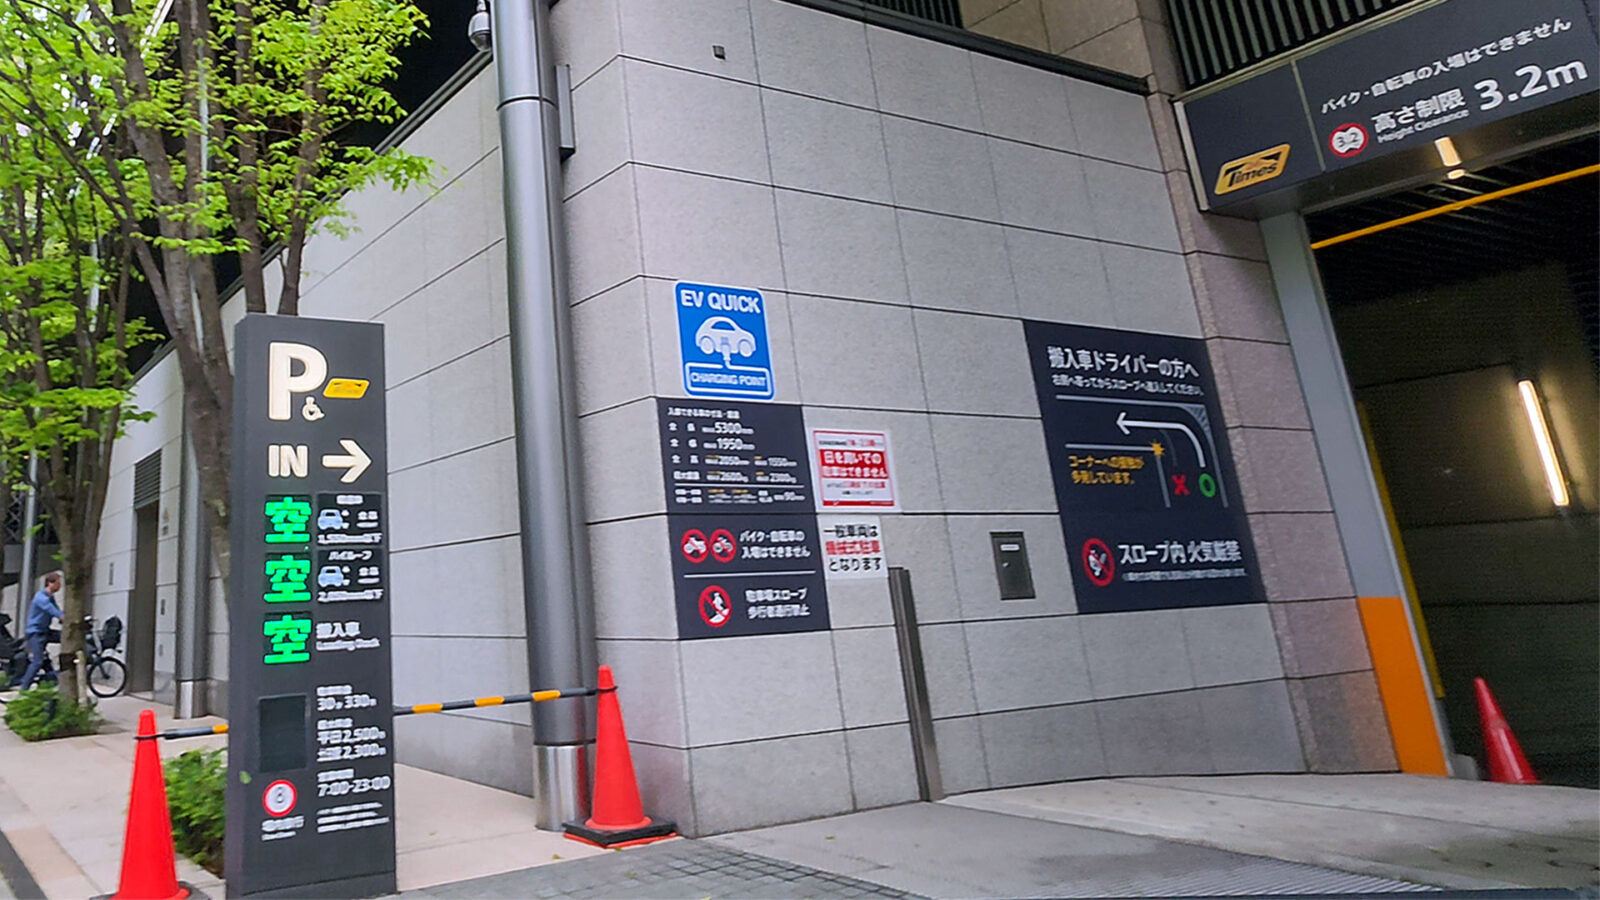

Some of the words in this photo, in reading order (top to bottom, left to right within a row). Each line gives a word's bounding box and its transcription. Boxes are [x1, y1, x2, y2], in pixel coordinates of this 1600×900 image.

[1321, 18, 1572, 114] バイク・自転車の入場はできません
[1371, 88, 1466, 134] 高さ制限
[1474, 59, 1588, 111] 3.2m
[1377, 125, 1412, 144] Height
[1226, 162, 1278, 188] Times
[680, 289, 704, 308] EV
[707, 292, 761, 313] QUICK
[1047, 346, 1200, 379] 搬入車ドライバーの方へ
[268, 341, 328, 421] P
[691, 372, 738, 385] CHARGING
[738, 375, 767, 386] POINT
[268, 445, 308, 478] IN
[264, 496, 312, 543] 空
[823, 525, 879, 539] 一般車両は
[739, 530, 806, 543] バイク・自転車の
[741, 545, 812, 559] 入場はできません
[828, 557, 882, 573] となります
[1117, 543, 1188, 565] スロープ内
[263, 554, 312, 602] 空
[263, 614, 312, 664] 空
